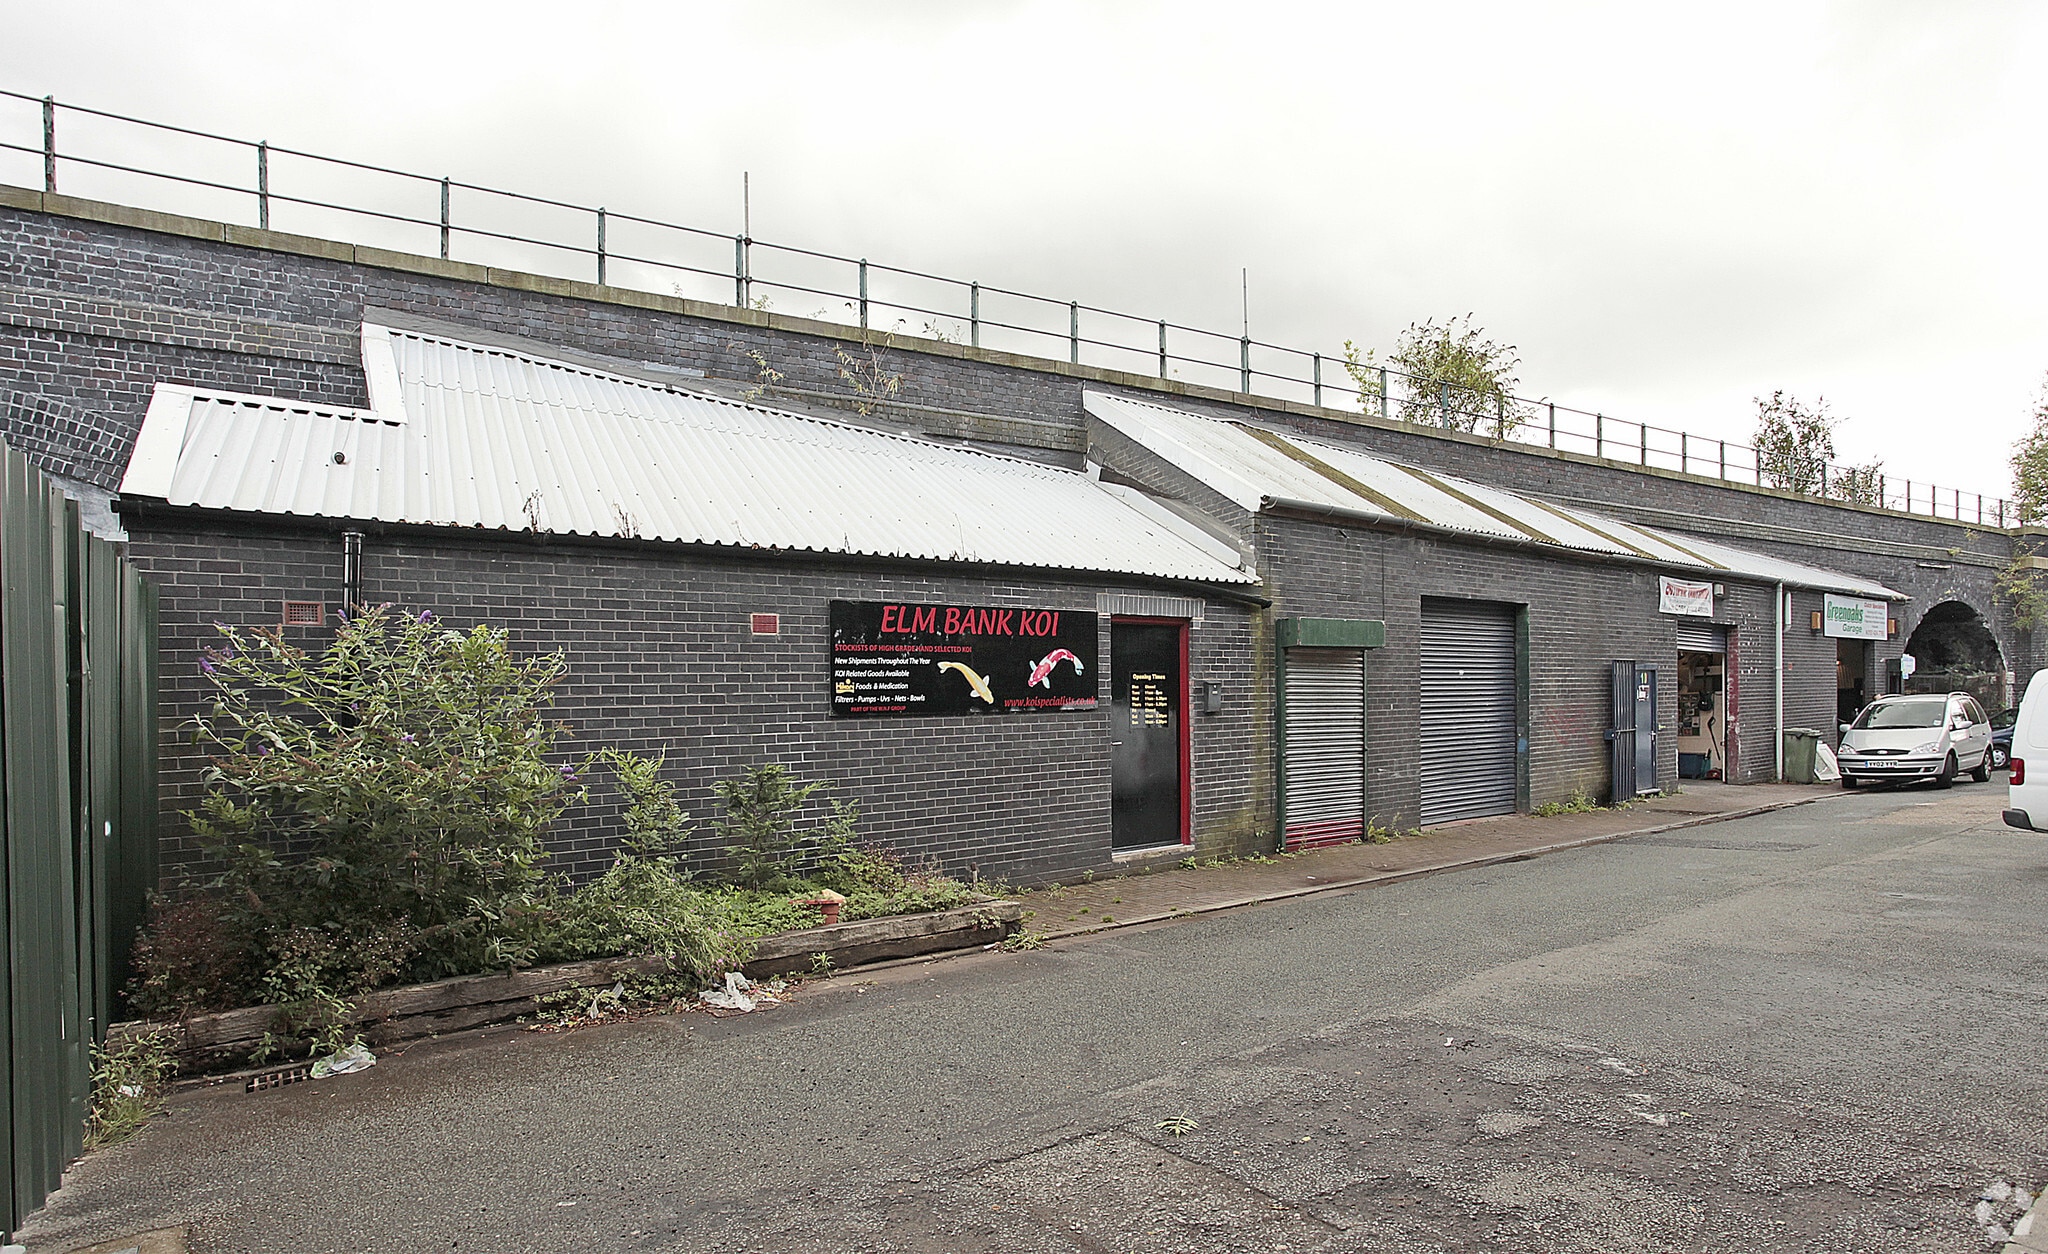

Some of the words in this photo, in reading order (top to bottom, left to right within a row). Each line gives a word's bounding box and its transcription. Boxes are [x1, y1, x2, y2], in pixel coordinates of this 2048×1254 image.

[1827, 601, 1863, 622] Greenoaks
[881, 605, 937, 634] ELM
[944, 607, 1013, 636] BANK
[1018, 610, 1059, 637] KOI
[1842, 623, 1862, 635] Garage
[835, 644, 868, 652] STOCKISTS
[916, 645, 934, 653] HAND
[834, 657, 847, 665] New
[848, 657, 877, 666] Shipments
[878, 657, 909, 667] Throughout
[909, 657, 919, 665] The
[919, 657, 931, 665] Year
[834, 669, 846, 677] KOI
[846, 669, 867, 678] Related
[867, 669, 885, 678] Goods
[885, 669, 910, 677] Available
[855, 682, 872, 690] Foods
[873, 682, 878, 690] &
[879, 681, 909, 690] Medication
[858, 695, 877, 704] Pumps
[894, 694, 907, 702] Nets
[910, 693, 926, 702] Bowls
[1004, 695, 1096, 708] www.koispecialists.co.uk
